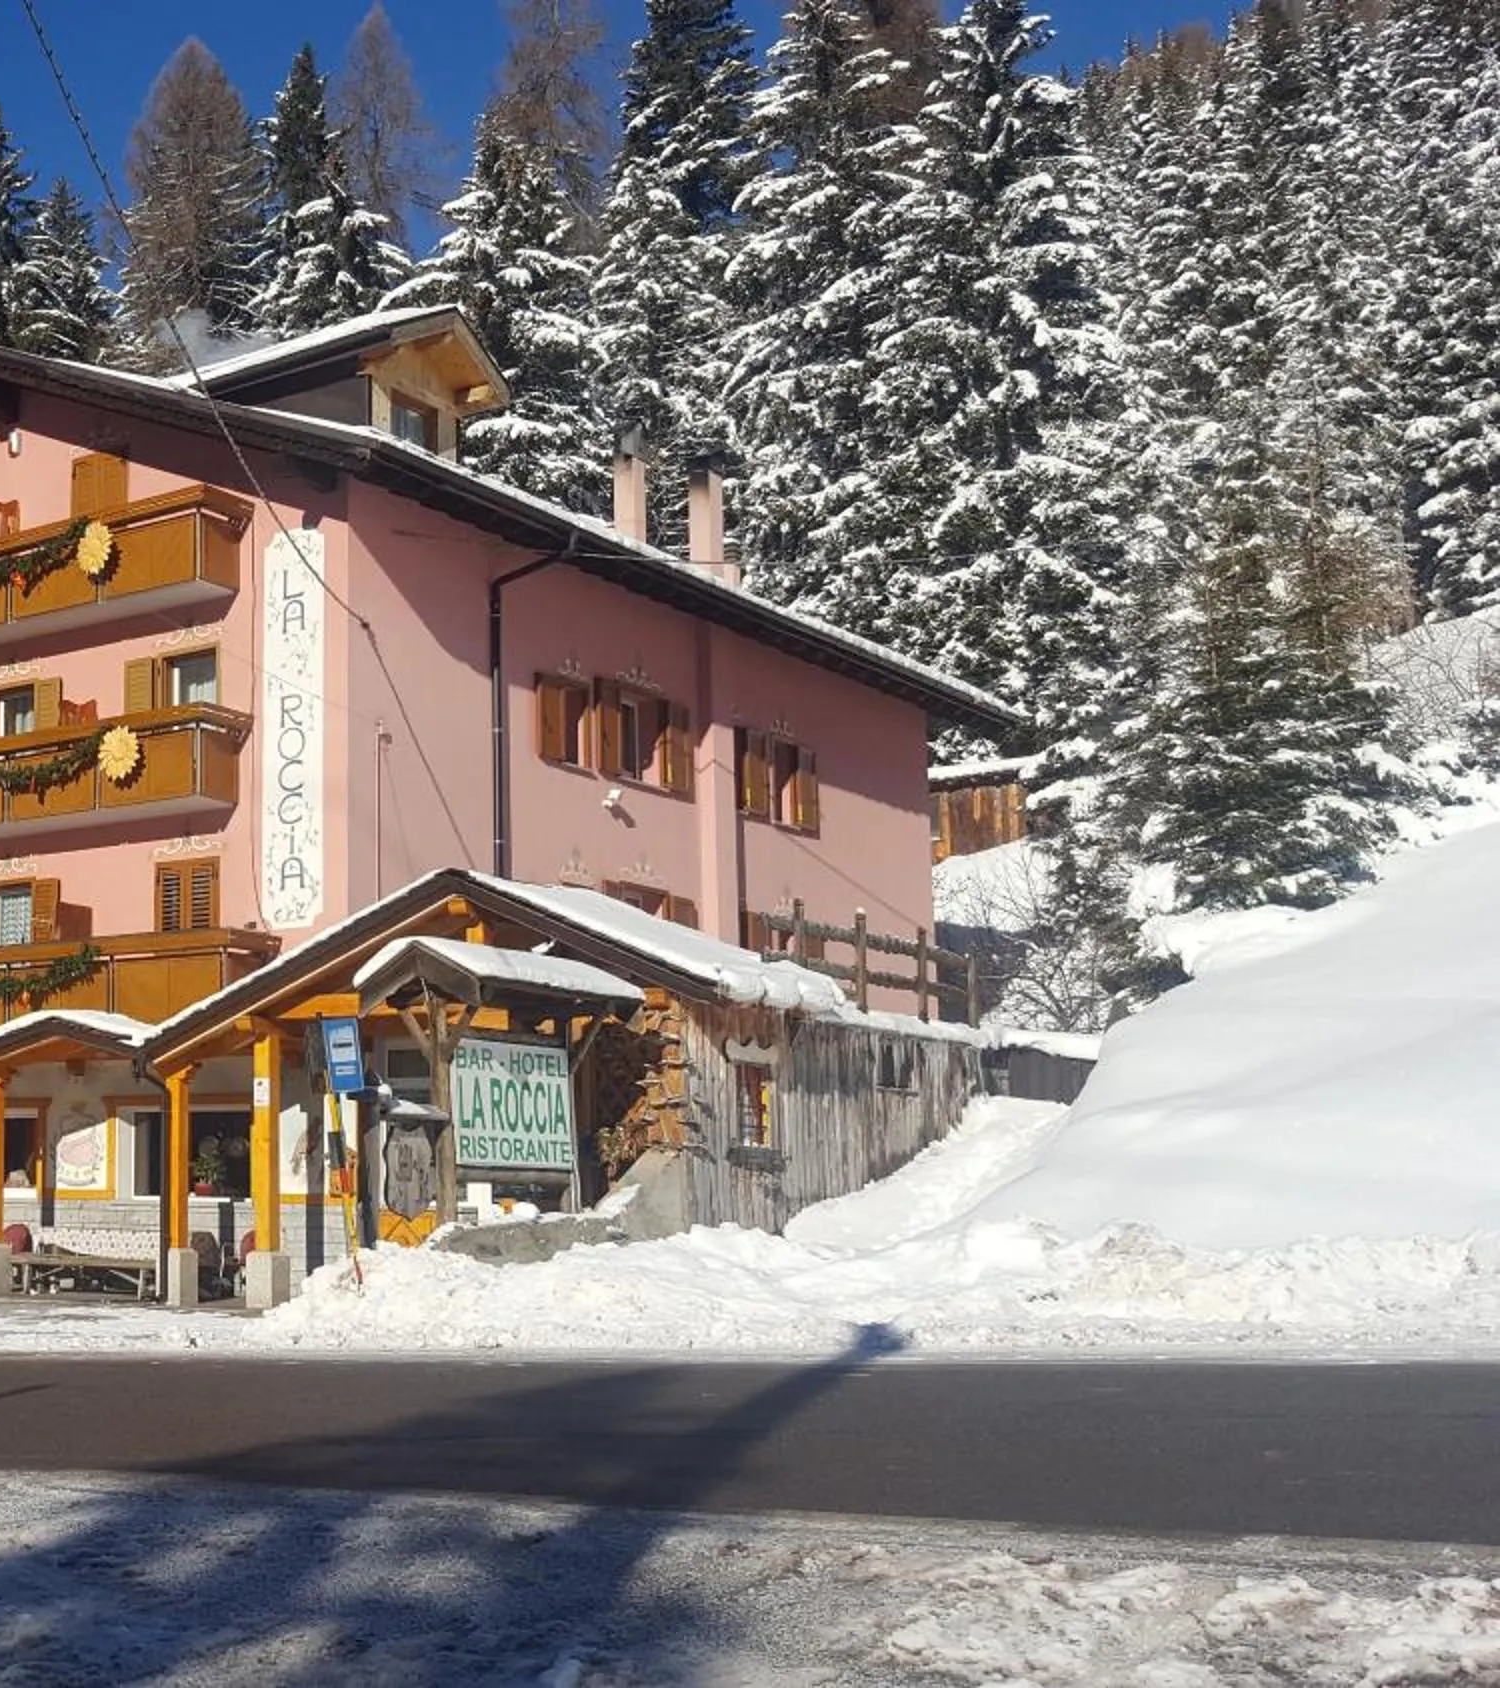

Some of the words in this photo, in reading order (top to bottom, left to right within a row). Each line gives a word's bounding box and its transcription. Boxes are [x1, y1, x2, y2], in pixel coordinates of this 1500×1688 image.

[282, 569, 306, 635] LA
[456, 1047, 493, 1071] BAR
[509, 1049, 567, 1079] HOTEL
[457, 1075, 486, 1130] LA
[488, 1077, 568, 1135] ROCCIA
[459, 1135, 573, 1163] RISTORANTE
